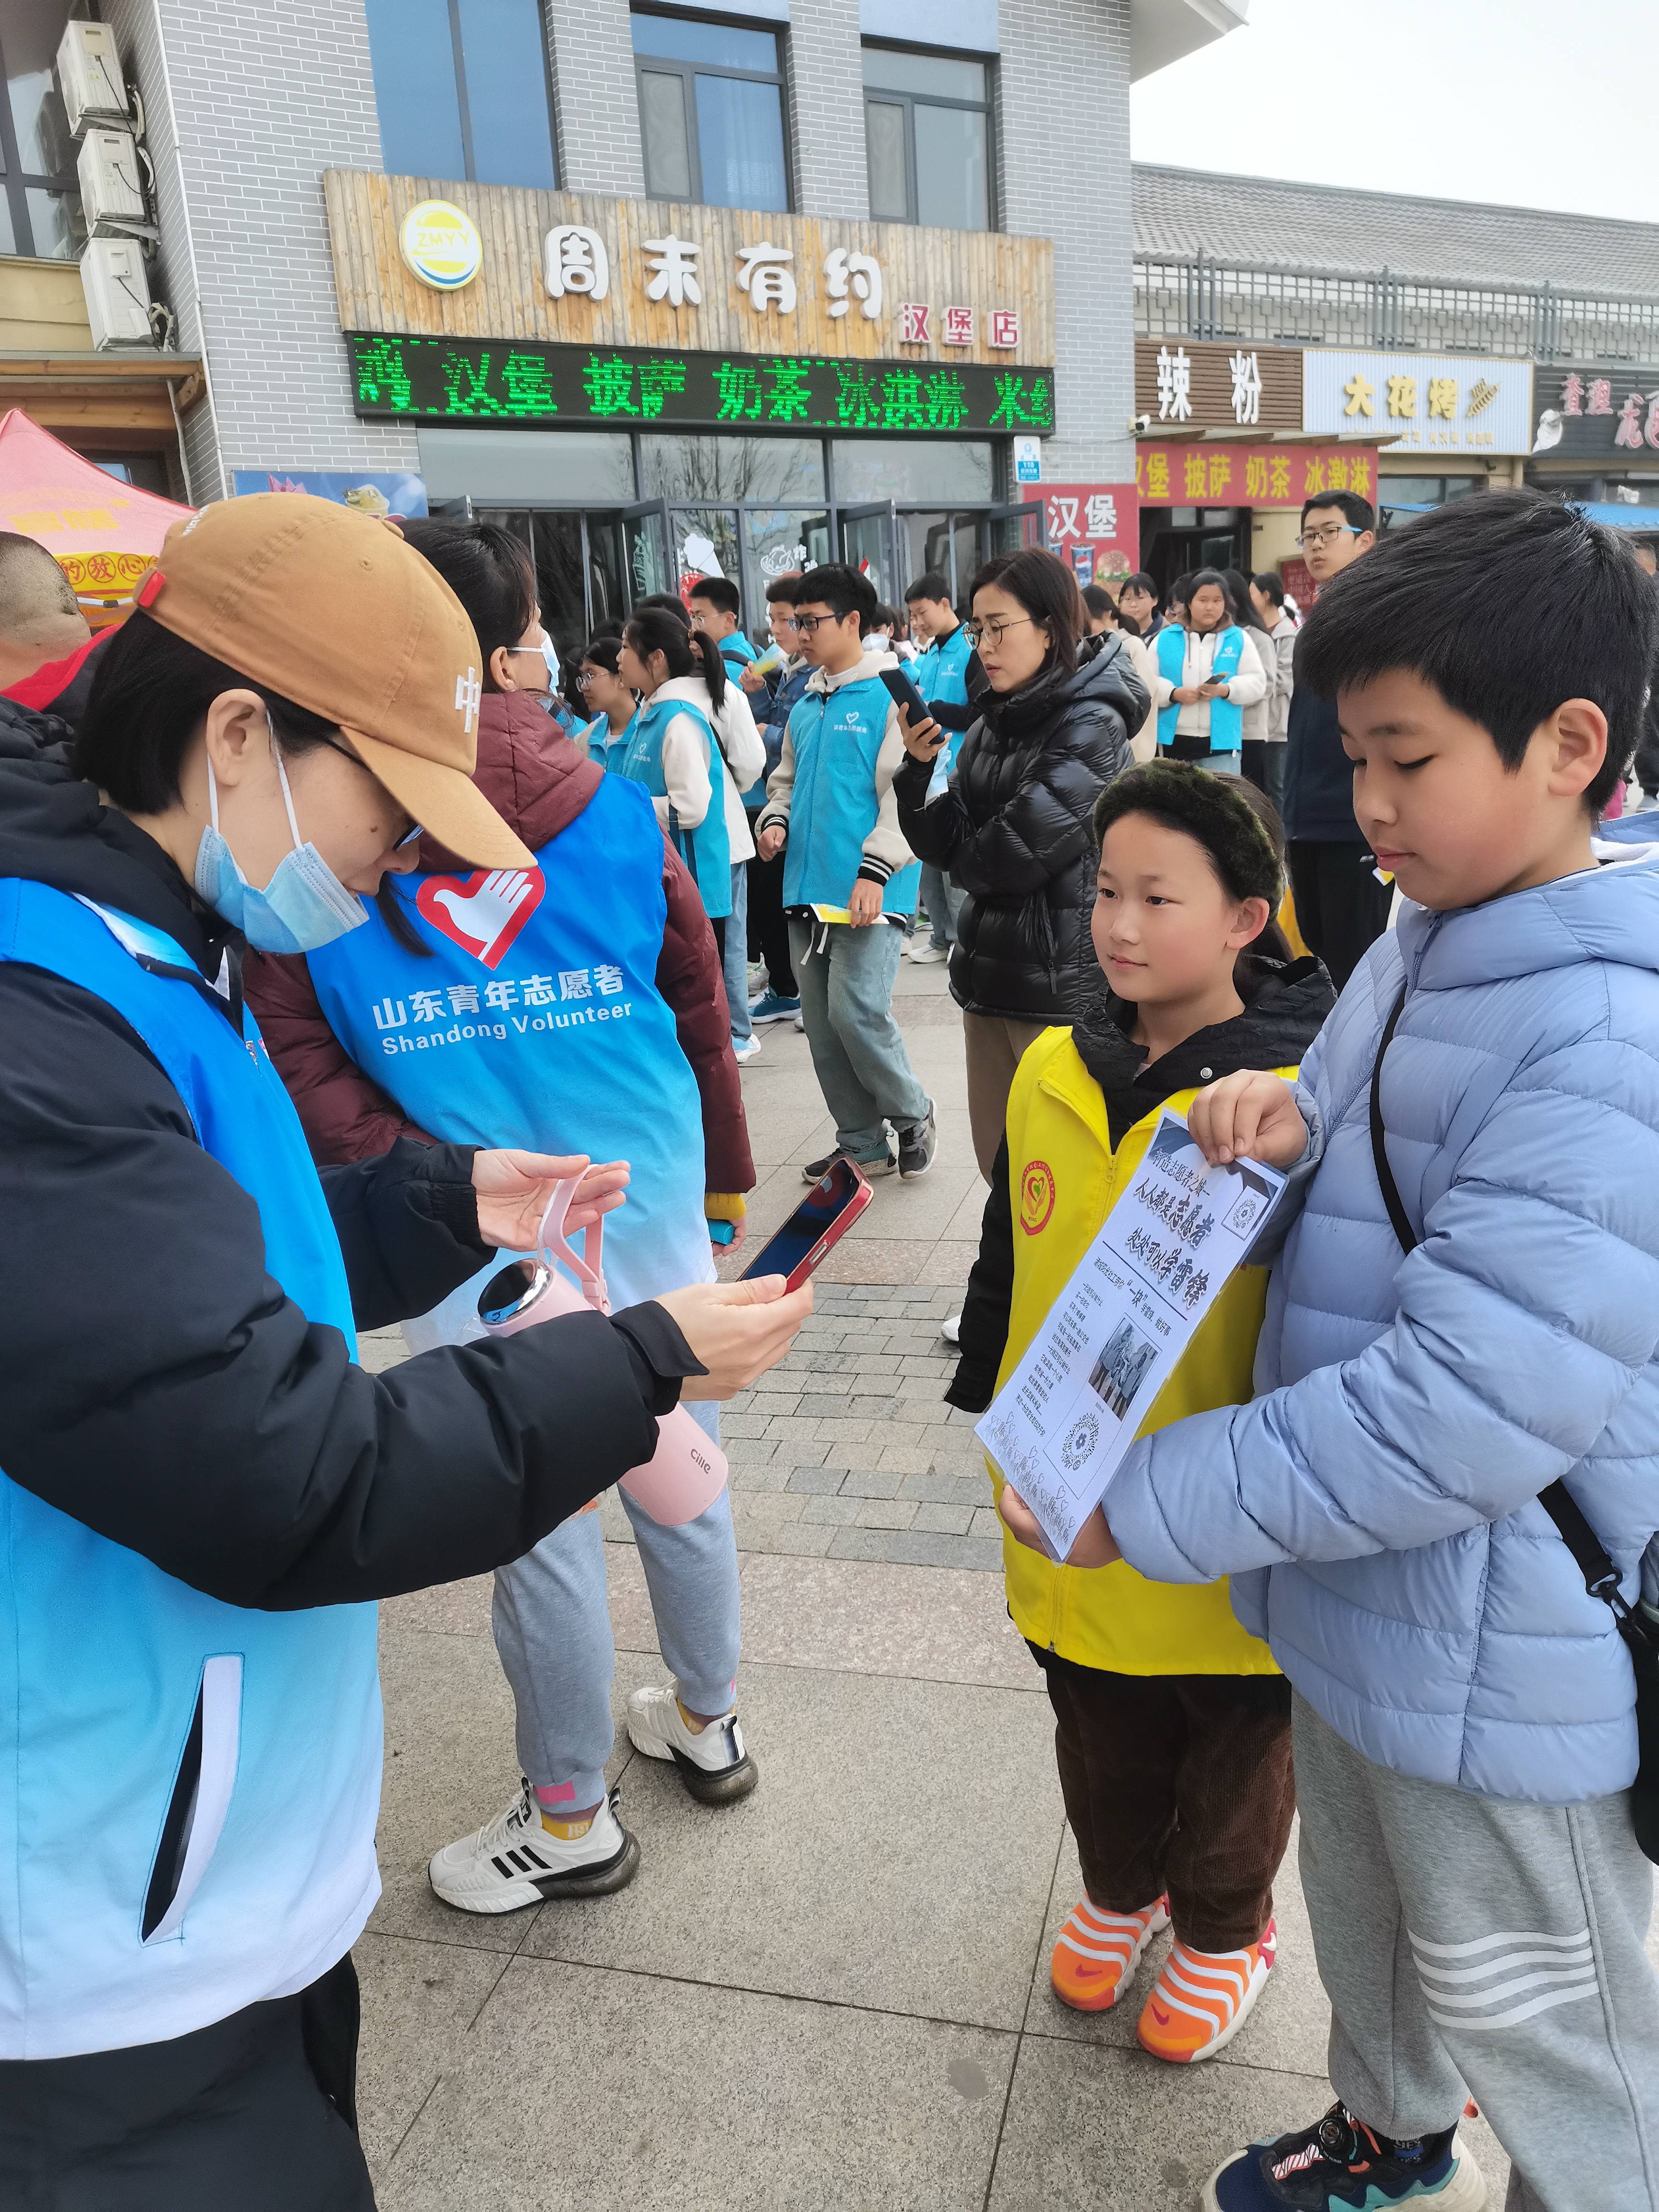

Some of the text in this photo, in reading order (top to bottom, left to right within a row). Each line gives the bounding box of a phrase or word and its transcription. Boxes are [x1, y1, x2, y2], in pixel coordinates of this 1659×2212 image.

[416, 231, 469, 247] ZMYY
[544, 224, 882, 320] 周末有约
[900, 303, 1020, 349] 汉堡店
[441, 349, 559, 417] 汉堡
[583, 352, 687, 418] 披萨
[712, 359, 812, 422] 奶茶
[1156, 346, 1262, 424] 辣粉
[1184, 453, 1232, 498] 披萨
[1246, 455, 1291, 498] 奶茶
[1047, 494, 1118, 539] 汉堡
[59, 554, 158, 582] 的放心
[372, 964, 625, 1030] 山东青年志愿者
[382, 1001, 632, 1056] Shandong Volunteer
[1134, 1178, 1215, 1248] 人人都是志愿者
[1126, 1226, 1210, 1309] 处处可以学雷锋
